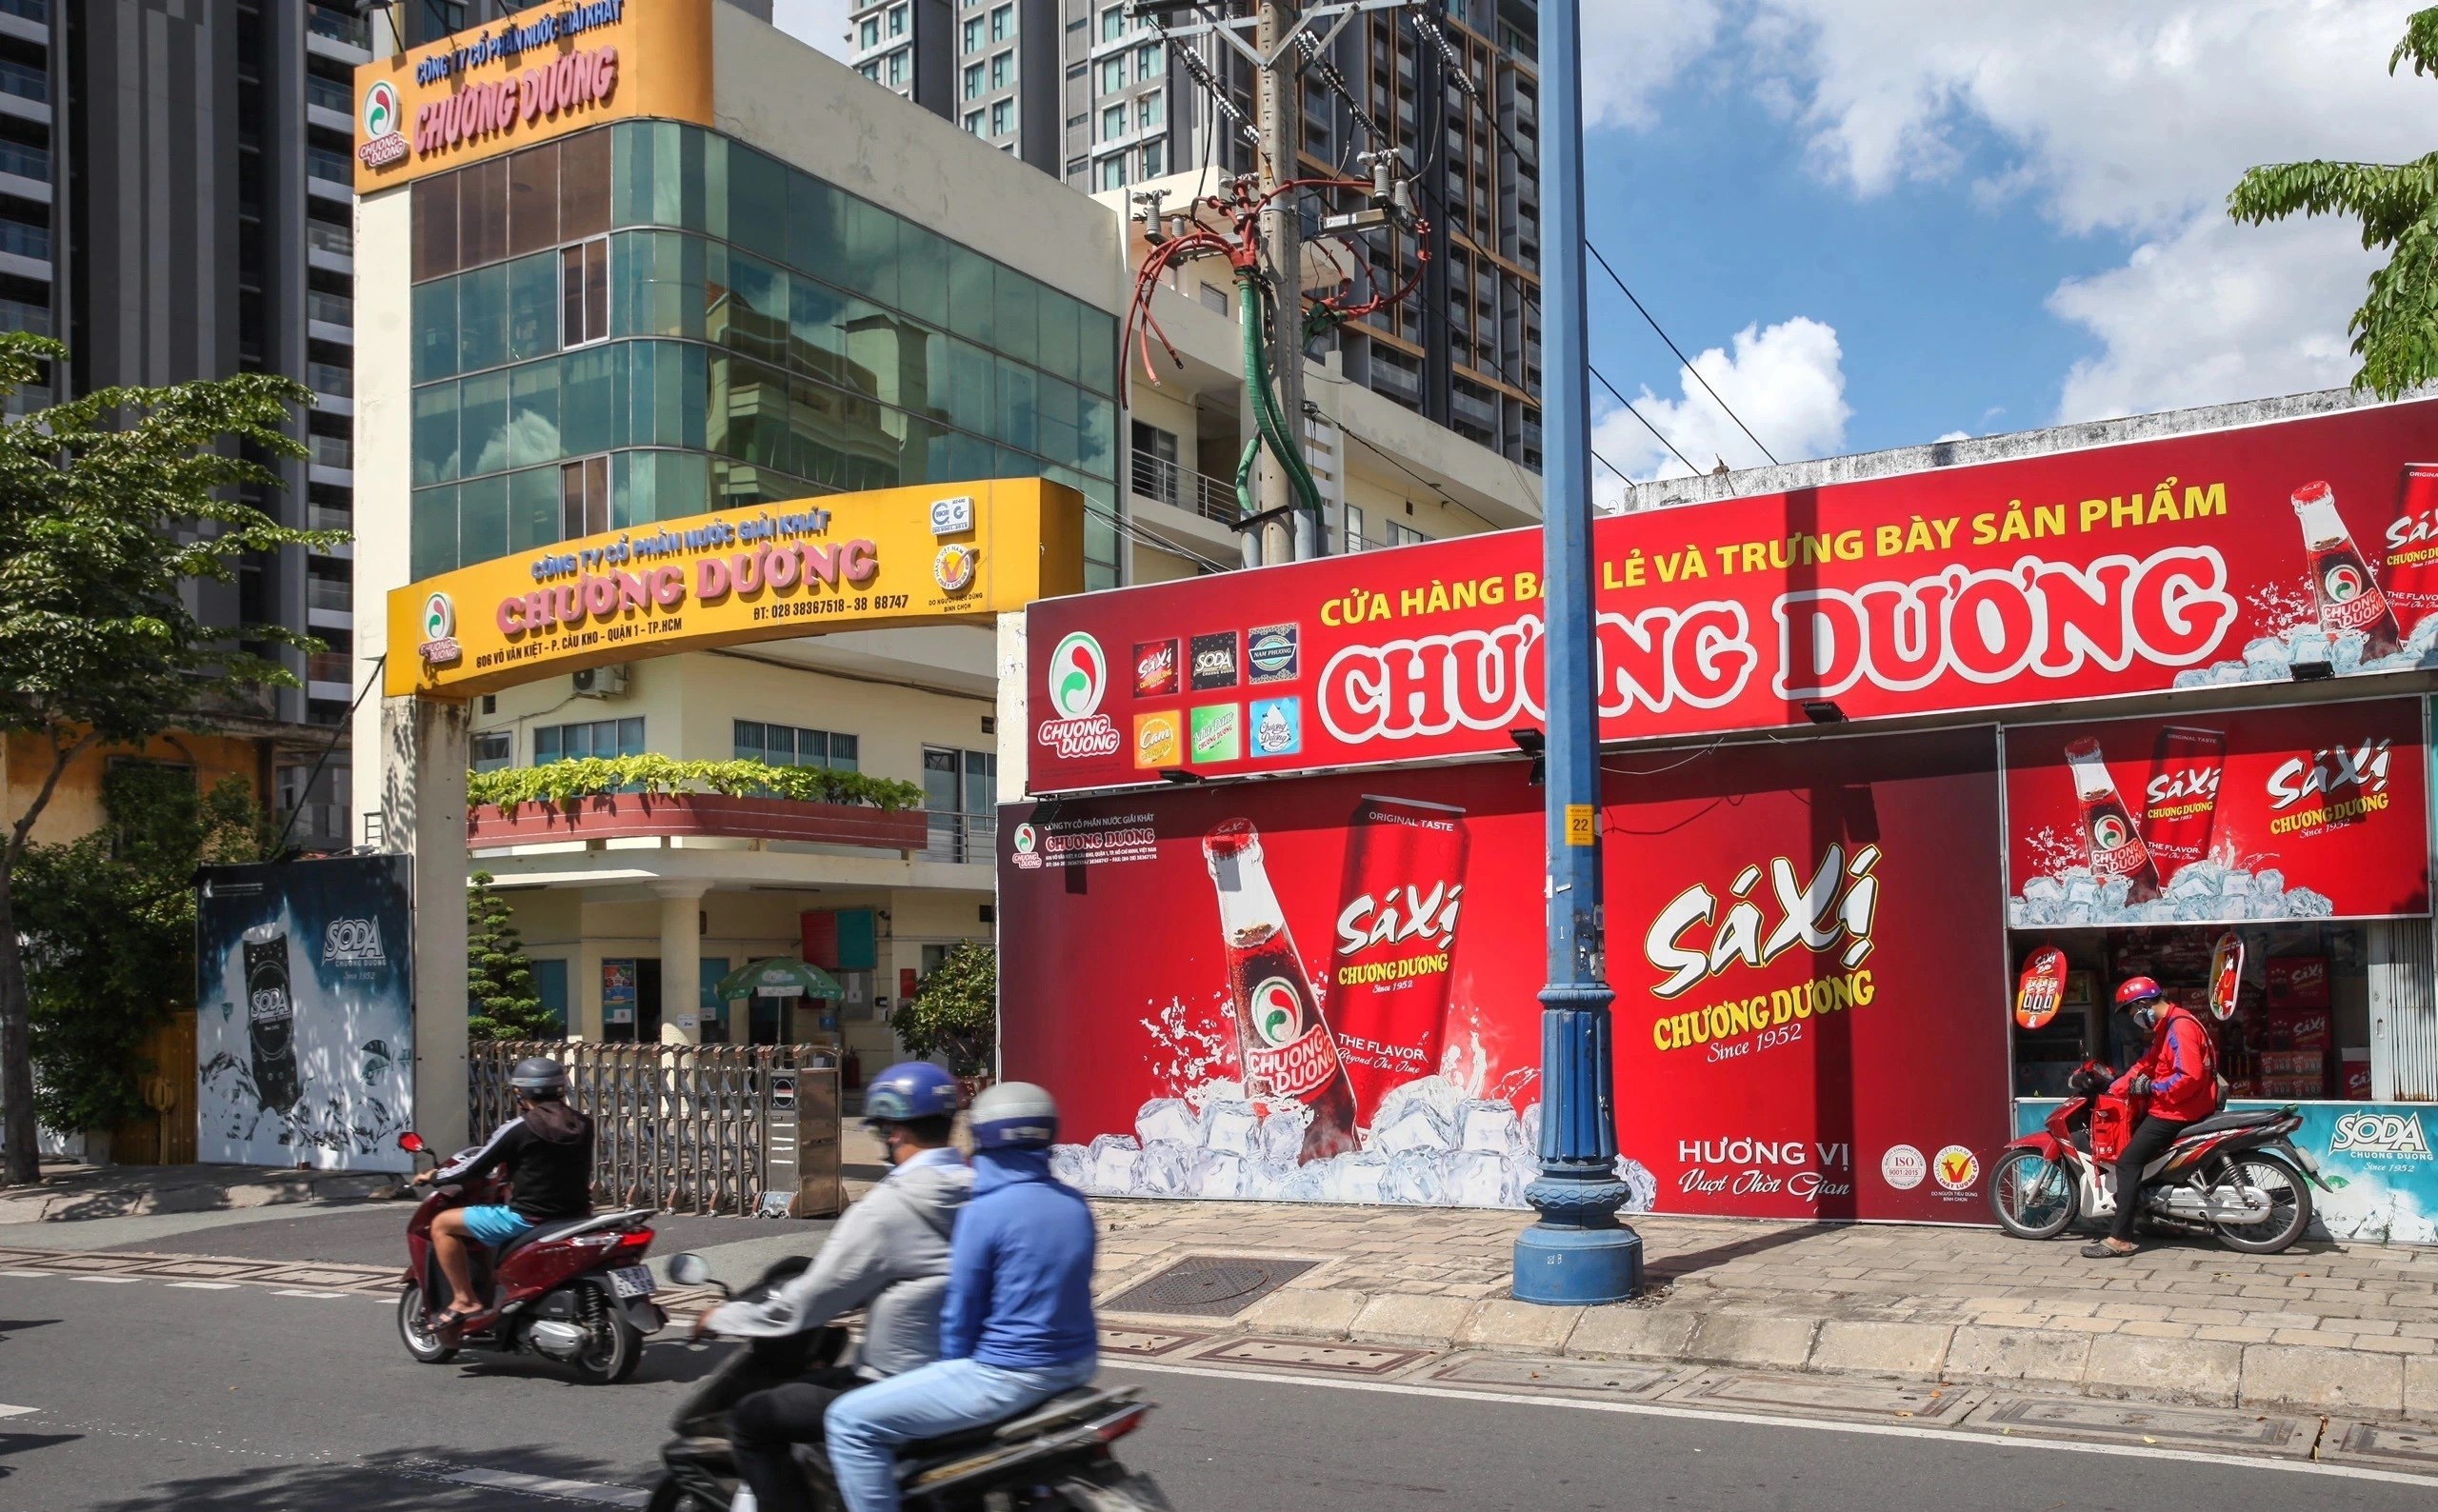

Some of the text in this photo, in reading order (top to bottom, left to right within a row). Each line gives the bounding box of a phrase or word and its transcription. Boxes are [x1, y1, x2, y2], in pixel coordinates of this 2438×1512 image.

[450, 49, 468, 70] TY
[413, 45, 618, 154] CHƯƠNG DƯƠNG
[531, 553, 577, 580] CÔNG
[579, 547, 604, 571] TY
[605, 533, 629, 562] CỔ
[1320, 587, 1392, 627] CỬA
[1400, 579, 1505, 617] HÀNG
[1603, 548, 1646, 589] LẺ
[1652, 544, 1709, 583] VÀ
[1716, 529, 1864, 575] TRƯNG
[1876, 515, 1961, 557] BÀY
[1971, 499, 2066, 546] SẢN
[2080, 476, 2228, 532] PHẨM
[496, 539, 878, 636] CHƯƠNG DƯƠNG
[753, 607, 769, 620] ĐT:
[771, 604, 790, 618] 028
[793, 599, 845, 616] 38367518
[854, 597, 868, 611] 38
[2325, 592, 2376, 618] CHUONG
[2344, 595, 2385, 627] DUONG
[1771, 546, 2238, 700] DƯƠNG
[476, 618, 682, 668] 606 VÕ VĂN KIỆT P. CẦU KHO QUẬN 1 TP.HCM
[1253, 648, 1267, 658] NAM
[1193, 647, 1235, 677] SODA
[1042, 718, 1108, 741] CHUONG
[1061, 733, 1117, 754] DUONG
[1140, 726, 1170, 749] Cam
[2167, 733, 2196, 742] ORIGINAL
[2147, 766, 2222, 804] SáXị
[2266, 737, 2392, 810] SáXị
[1369, 811, 1454, 831] ORIGINAL TASTE
[1573, 818, 1589, 831] 22
[2270, 793, 2388, 834] CHƯƠNG DƯƠNG
[2300, 819, 2350, 839] Since 1952
[2093, 842, 2139, 865] CHUONG
[2109, 846, 2146, 872] DUONG
[2165, 845, 2199, 854] FLAVOR
[1336, 879, 1464, 956] SáXị
[1645, 842, 1882, 1000] SáXị
[321, 915, 386, 967] SODA
[1338, 953, 1449, 985] CHƯƠNG DƯƠNG
[1372, 980, 1413, 993] Since 1952
[250, 984, 291, 1023] SODA
[1653, 969, 1875, 1051] CHƯƠNG DƯƠNG
[1250, 1030, 1324, 1074] CHUONG
[1338, 1033, 1424, 1061] THE FLAVOR
[1707, 1023, 1803, 1063] Since 1952
[1275, 1041, 1334, 1091] DUONG
[1337, 1046, 1420, 1074] Beyond The Time
[2328, 1109, 2432, 1157] SODA
[1678, 1136, 1849, 1171] HƯƠNG VỊ
[1895, 1157, 1914, 1167] ISO
[1954, 1146, 1969, 1156] NAM
[2349, 1151, 2433, 1161] CHUONG DUONG
[2363, 1162, 2414, 1172] Since 1952
[1678, 1168, 1729, 1196] Vượt
[1787, 1171, 1849, 1202] Gian
